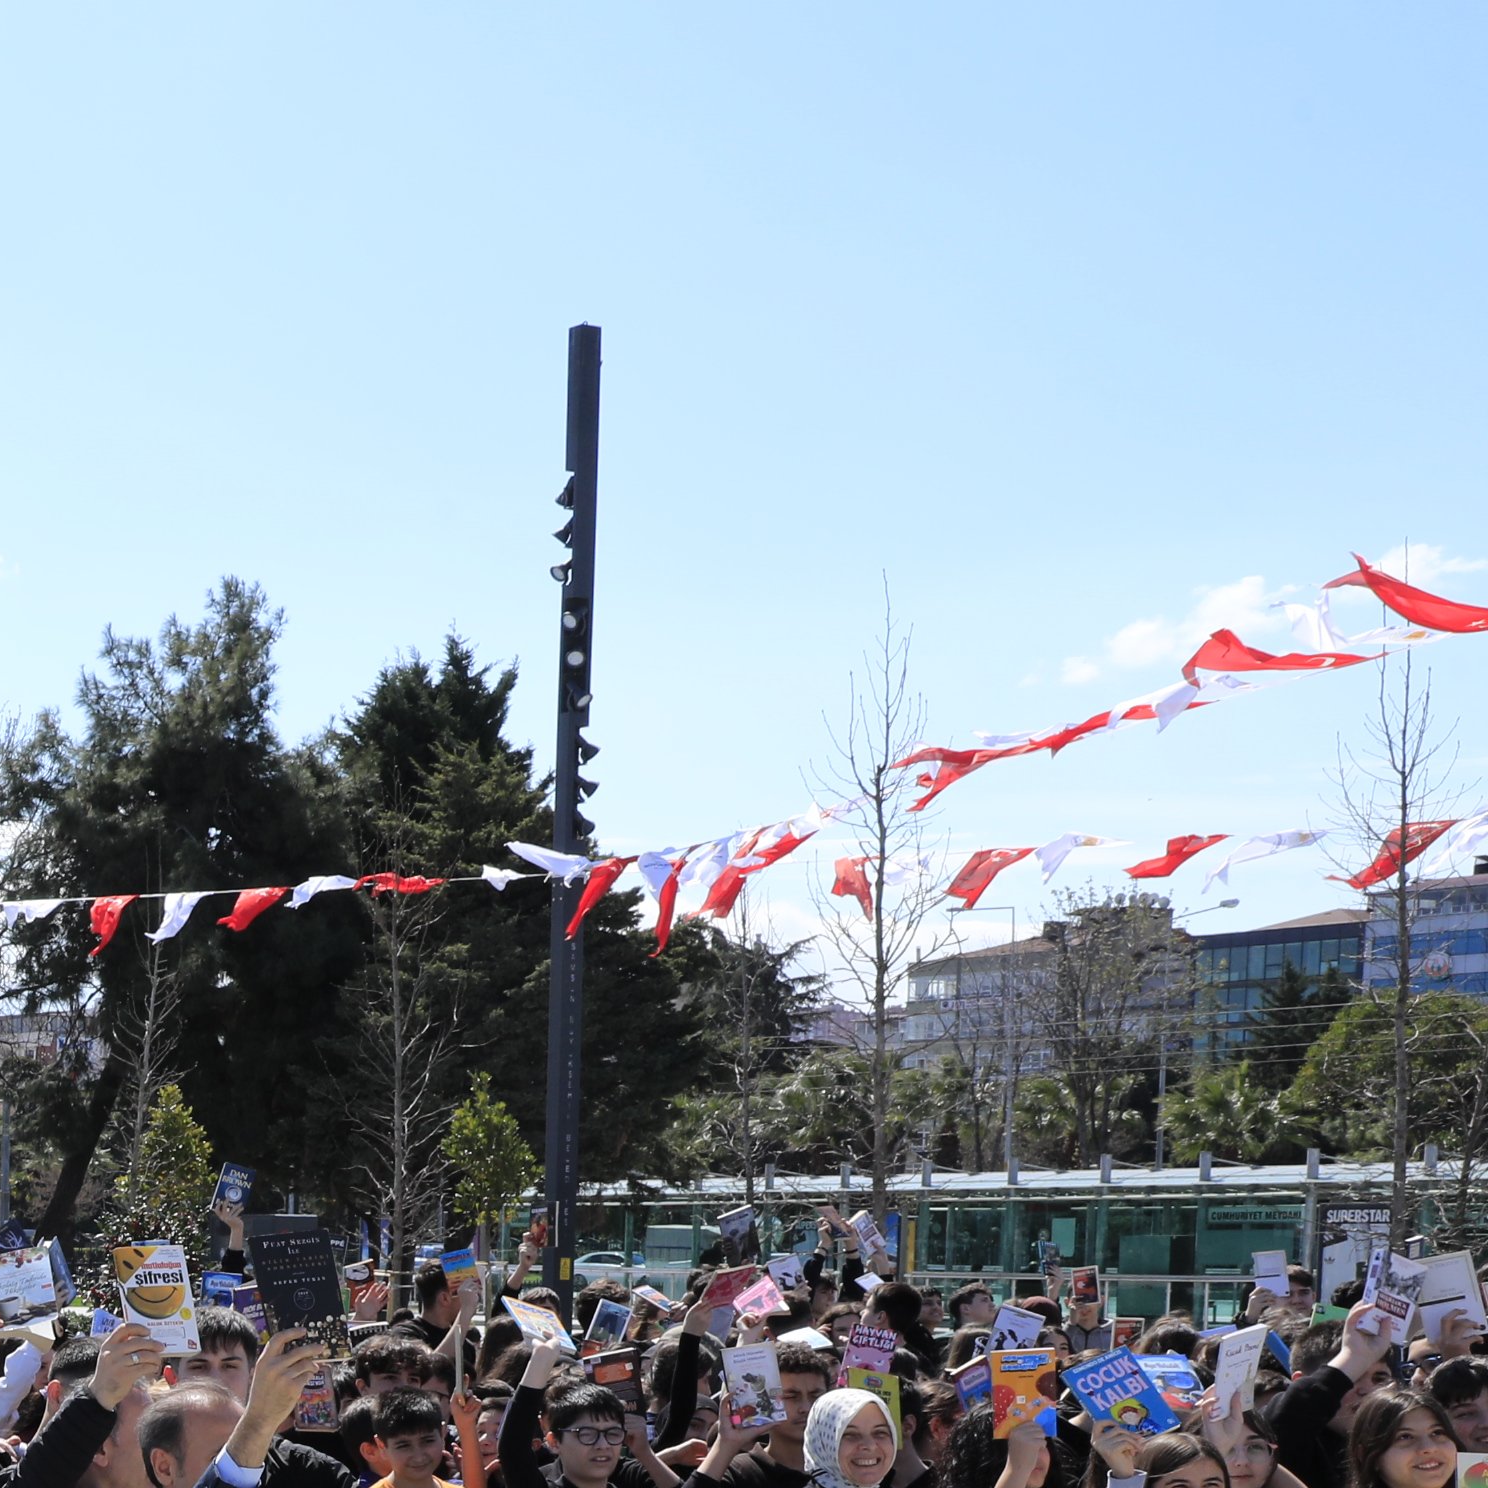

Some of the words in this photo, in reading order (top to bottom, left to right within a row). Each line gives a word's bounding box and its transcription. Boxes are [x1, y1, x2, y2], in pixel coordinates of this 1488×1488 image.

[222, 1174, 253, 1190] BROWN
[230, 1169, 249, 1181] DAN
[1326, 1208, 1391, 1224] SUPERSTAR
[262, 1240, 286, 1249] FUAT
[330, 1238, 345, 1249] PPÉ
[134, 1269, 184, 1287] şifresi
[854, 1324, 898, 1341] HAYVAN
[1076, 1354, 1139, 1396] ÇOCUK
